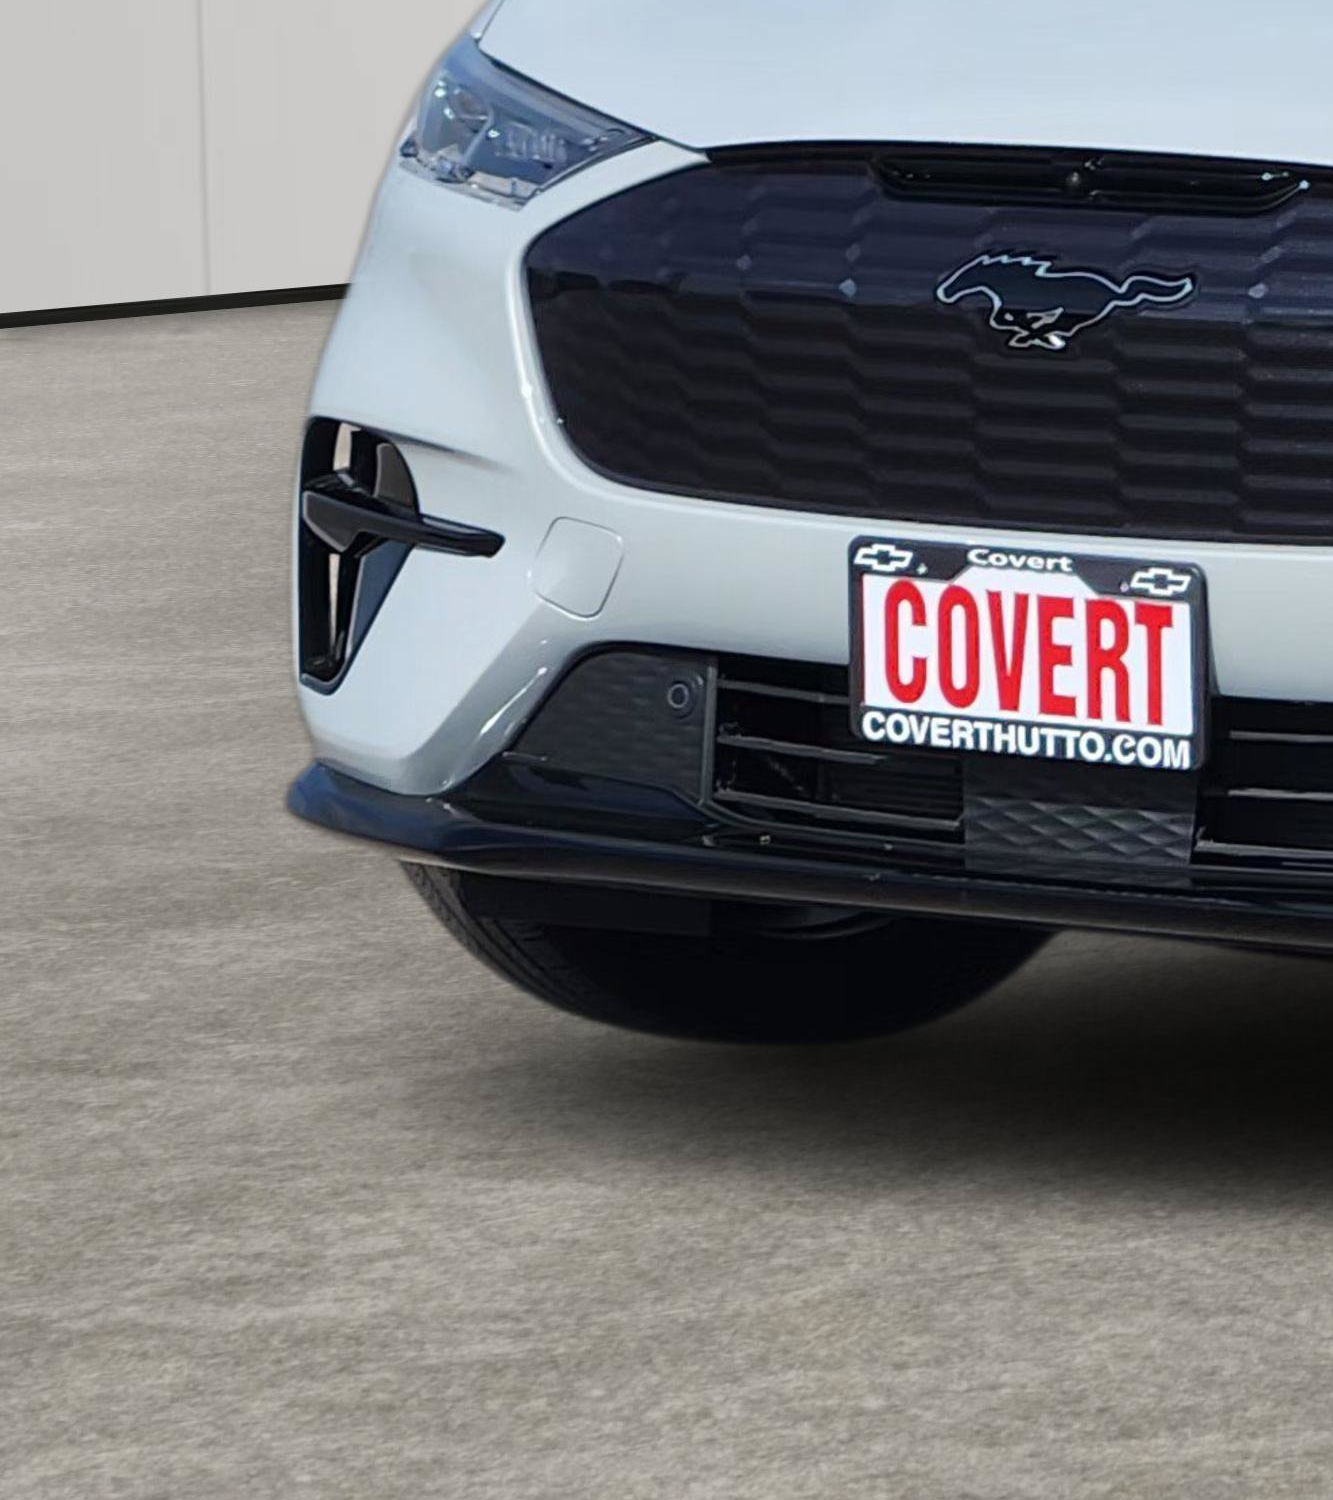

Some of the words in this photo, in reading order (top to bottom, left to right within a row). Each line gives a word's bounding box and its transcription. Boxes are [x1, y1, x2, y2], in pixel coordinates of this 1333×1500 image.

[966, 548, 1074, 573] Covert
[884, 576, 1174, 727] COVERT
[861, 710, 1192, 770] COVERTHUTTO.COM
